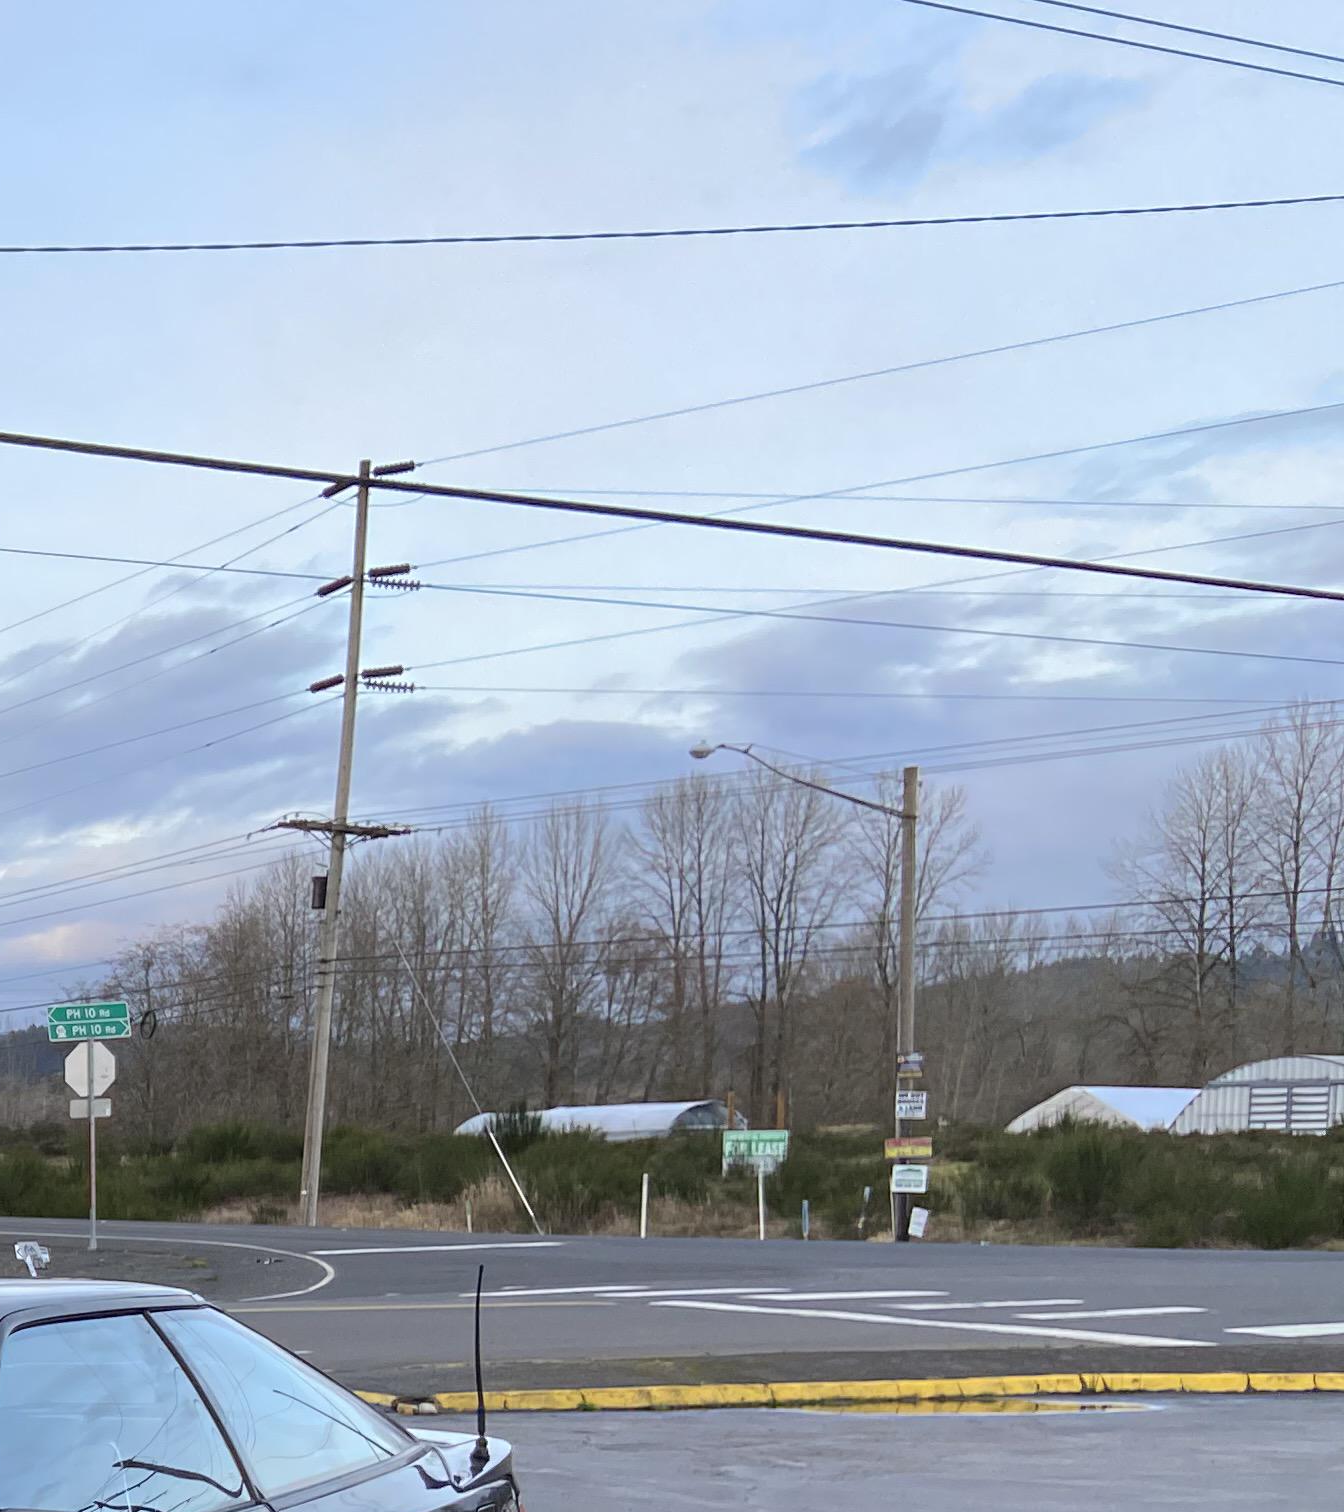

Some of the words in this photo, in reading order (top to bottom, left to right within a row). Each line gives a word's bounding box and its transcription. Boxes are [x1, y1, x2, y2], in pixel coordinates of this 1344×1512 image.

[66, 1008, 81, 1020] PH
[85, 1007, 96, 1019] 10
[99, 1009, 111, 1018] Rd
[72, 1025, 87, 1036] PH
[91, 1024, 102, 1035] 10
[105, 1026, 117, 1034] Rd
